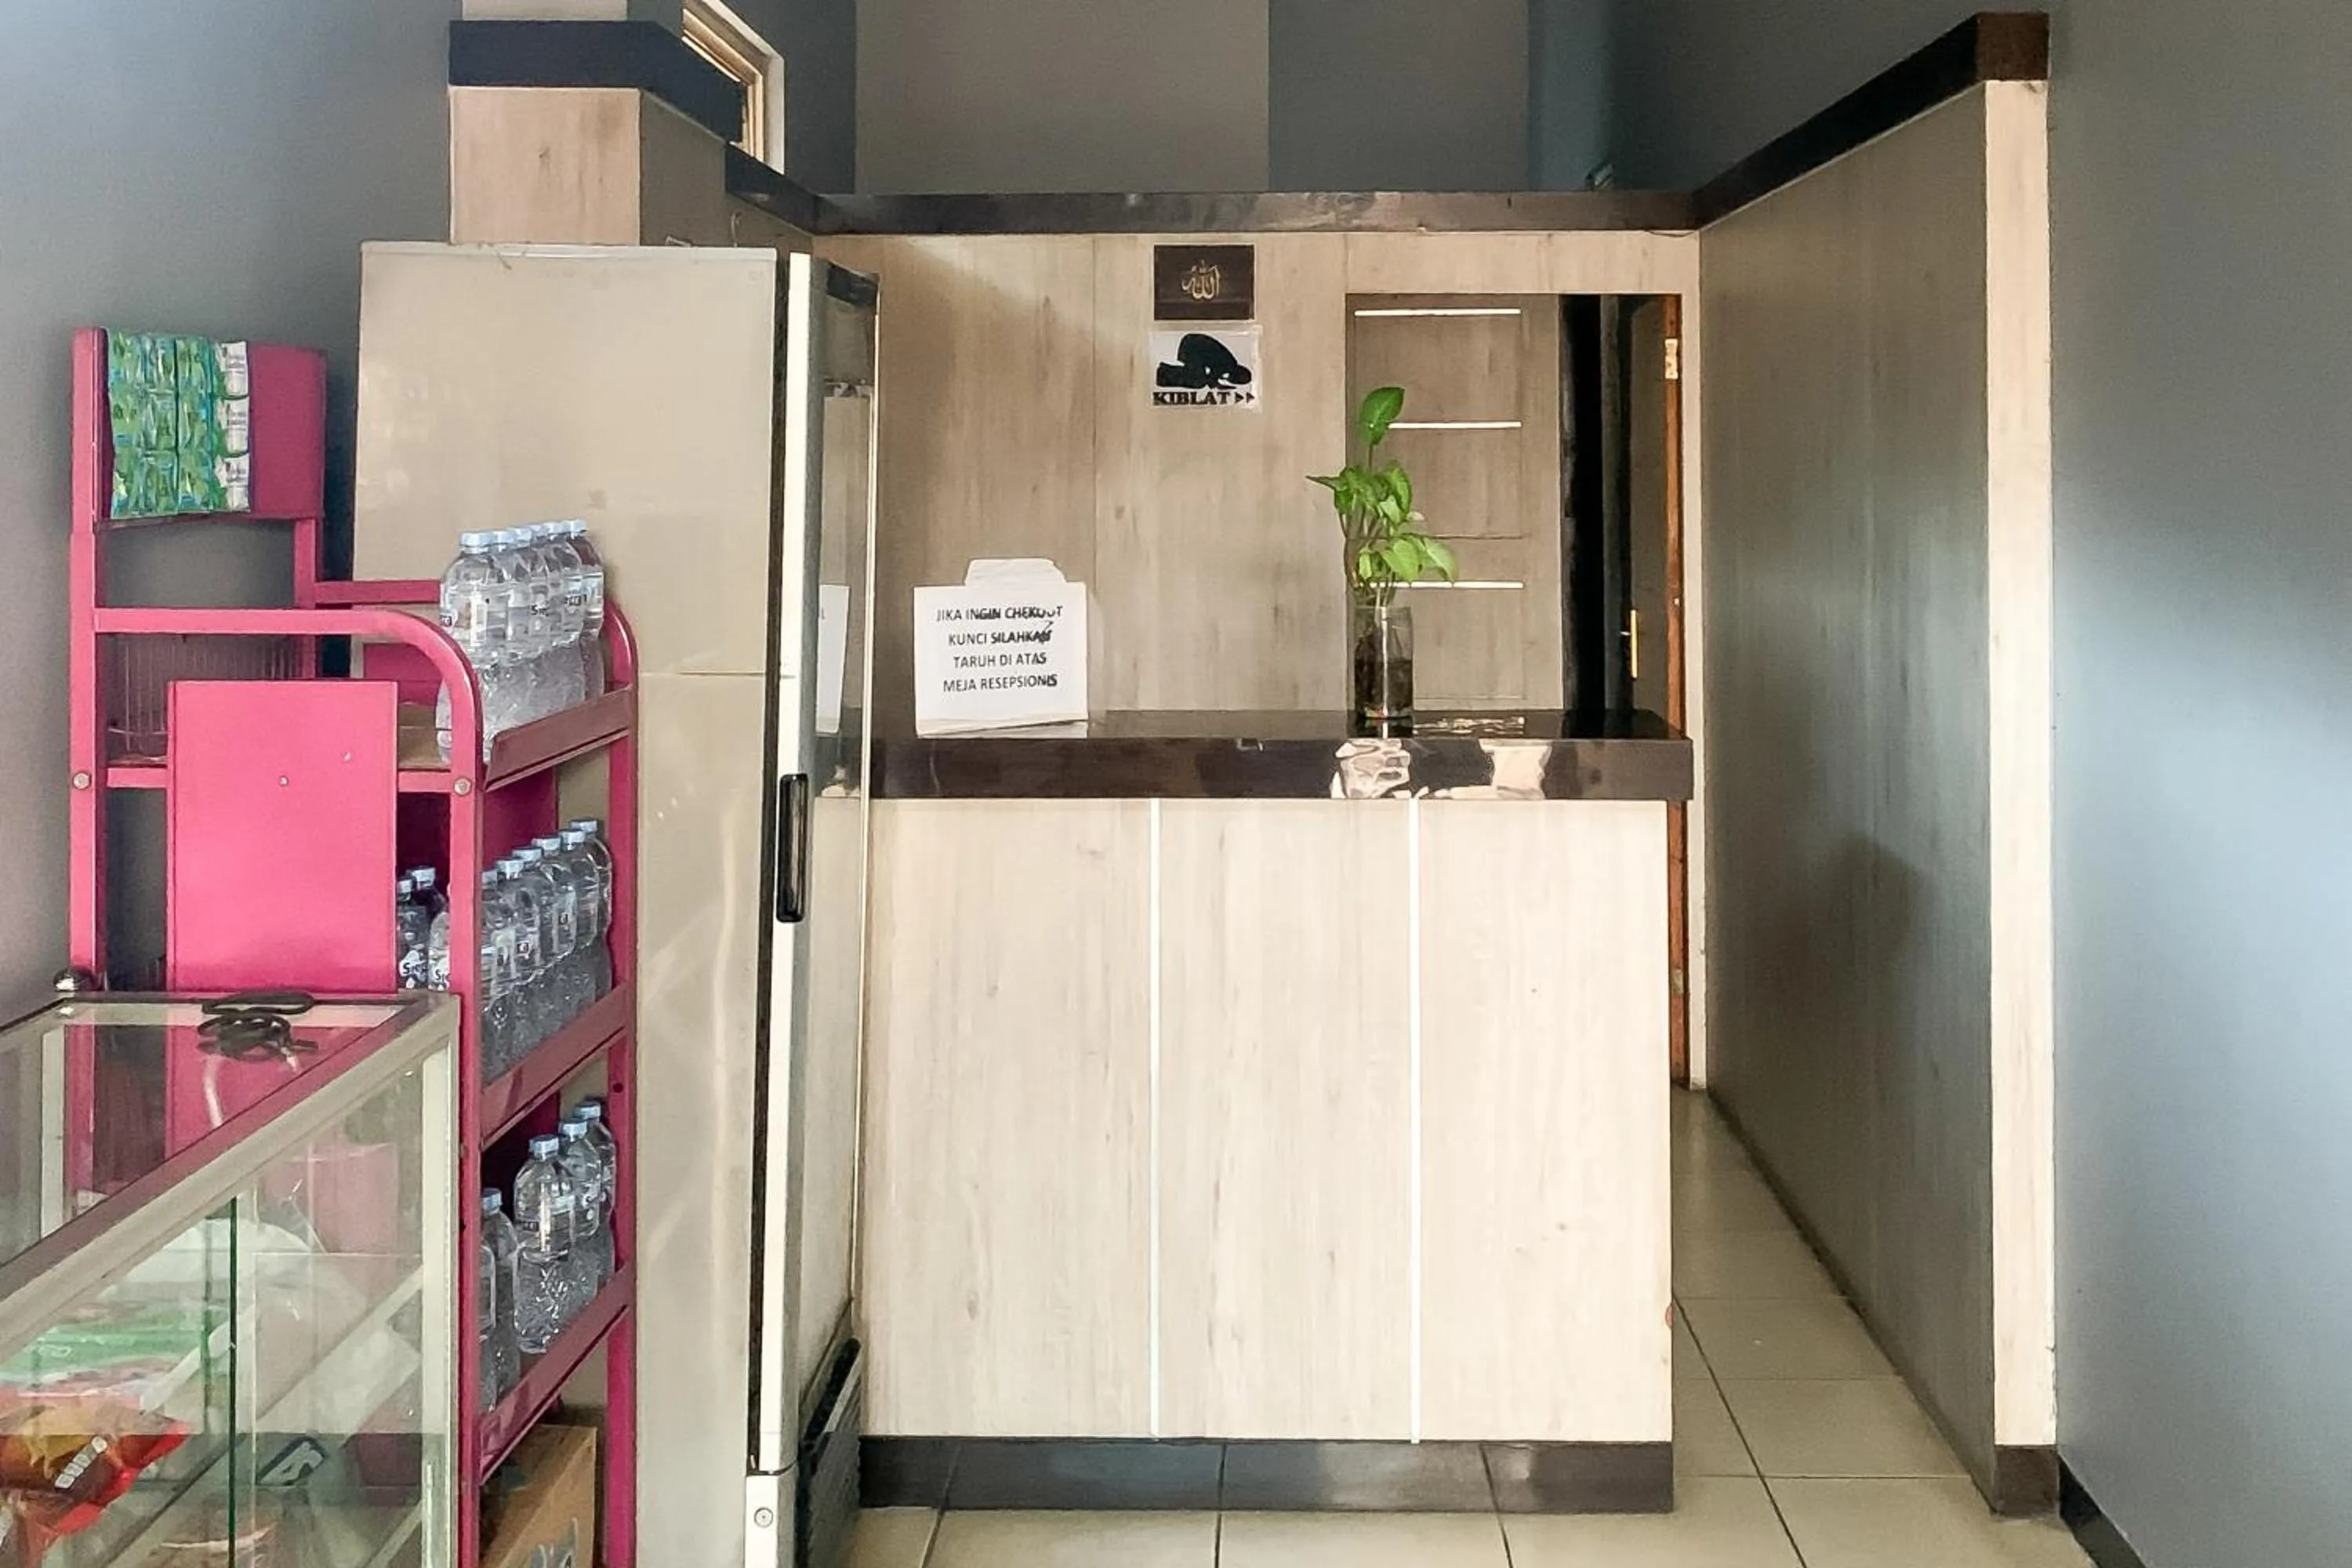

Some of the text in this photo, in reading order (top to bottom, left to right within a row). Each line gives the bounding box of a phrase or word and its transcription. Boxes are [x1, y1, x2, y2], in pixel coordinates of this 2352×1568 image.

[1152, 391, 1230, 405] KIBLAT
[937, 609, 962, 622] JIKA
[966, 608, 1001, 620] INGIN
[948, 633, 987, 646] KUNCI
[953, 652, 1047, 668] TARUH DI ATAS
[943, 673, 1058, 691] MEJA RESEPSIONIS
